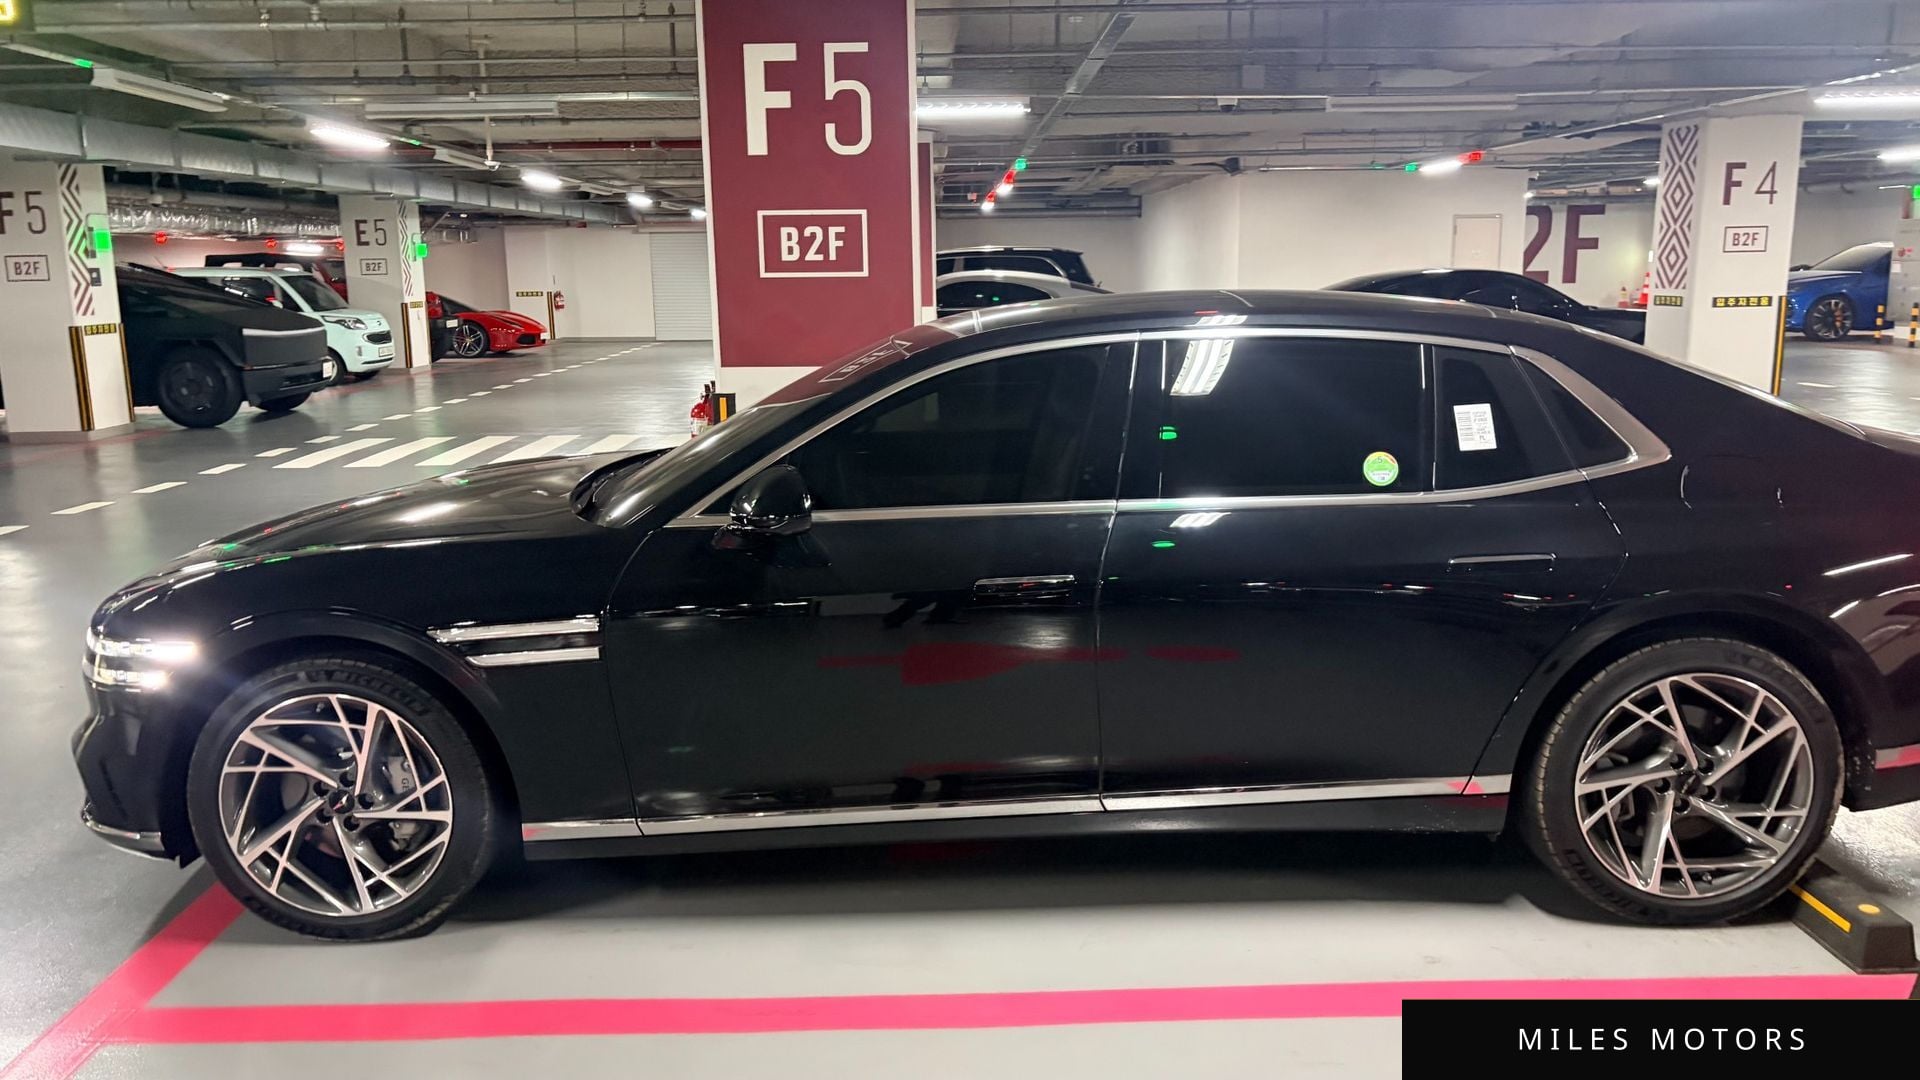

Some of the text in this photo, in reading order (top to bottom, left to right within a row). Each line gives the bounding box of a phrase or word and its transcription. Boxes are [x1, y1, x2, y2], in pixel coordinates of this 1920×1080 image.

[780, 226, 846, 261] B2F
[1732, 232, 1759, 246] B2F
[14, 261, 41, 276] B2F
[365, 262, 382, 272] B2F
